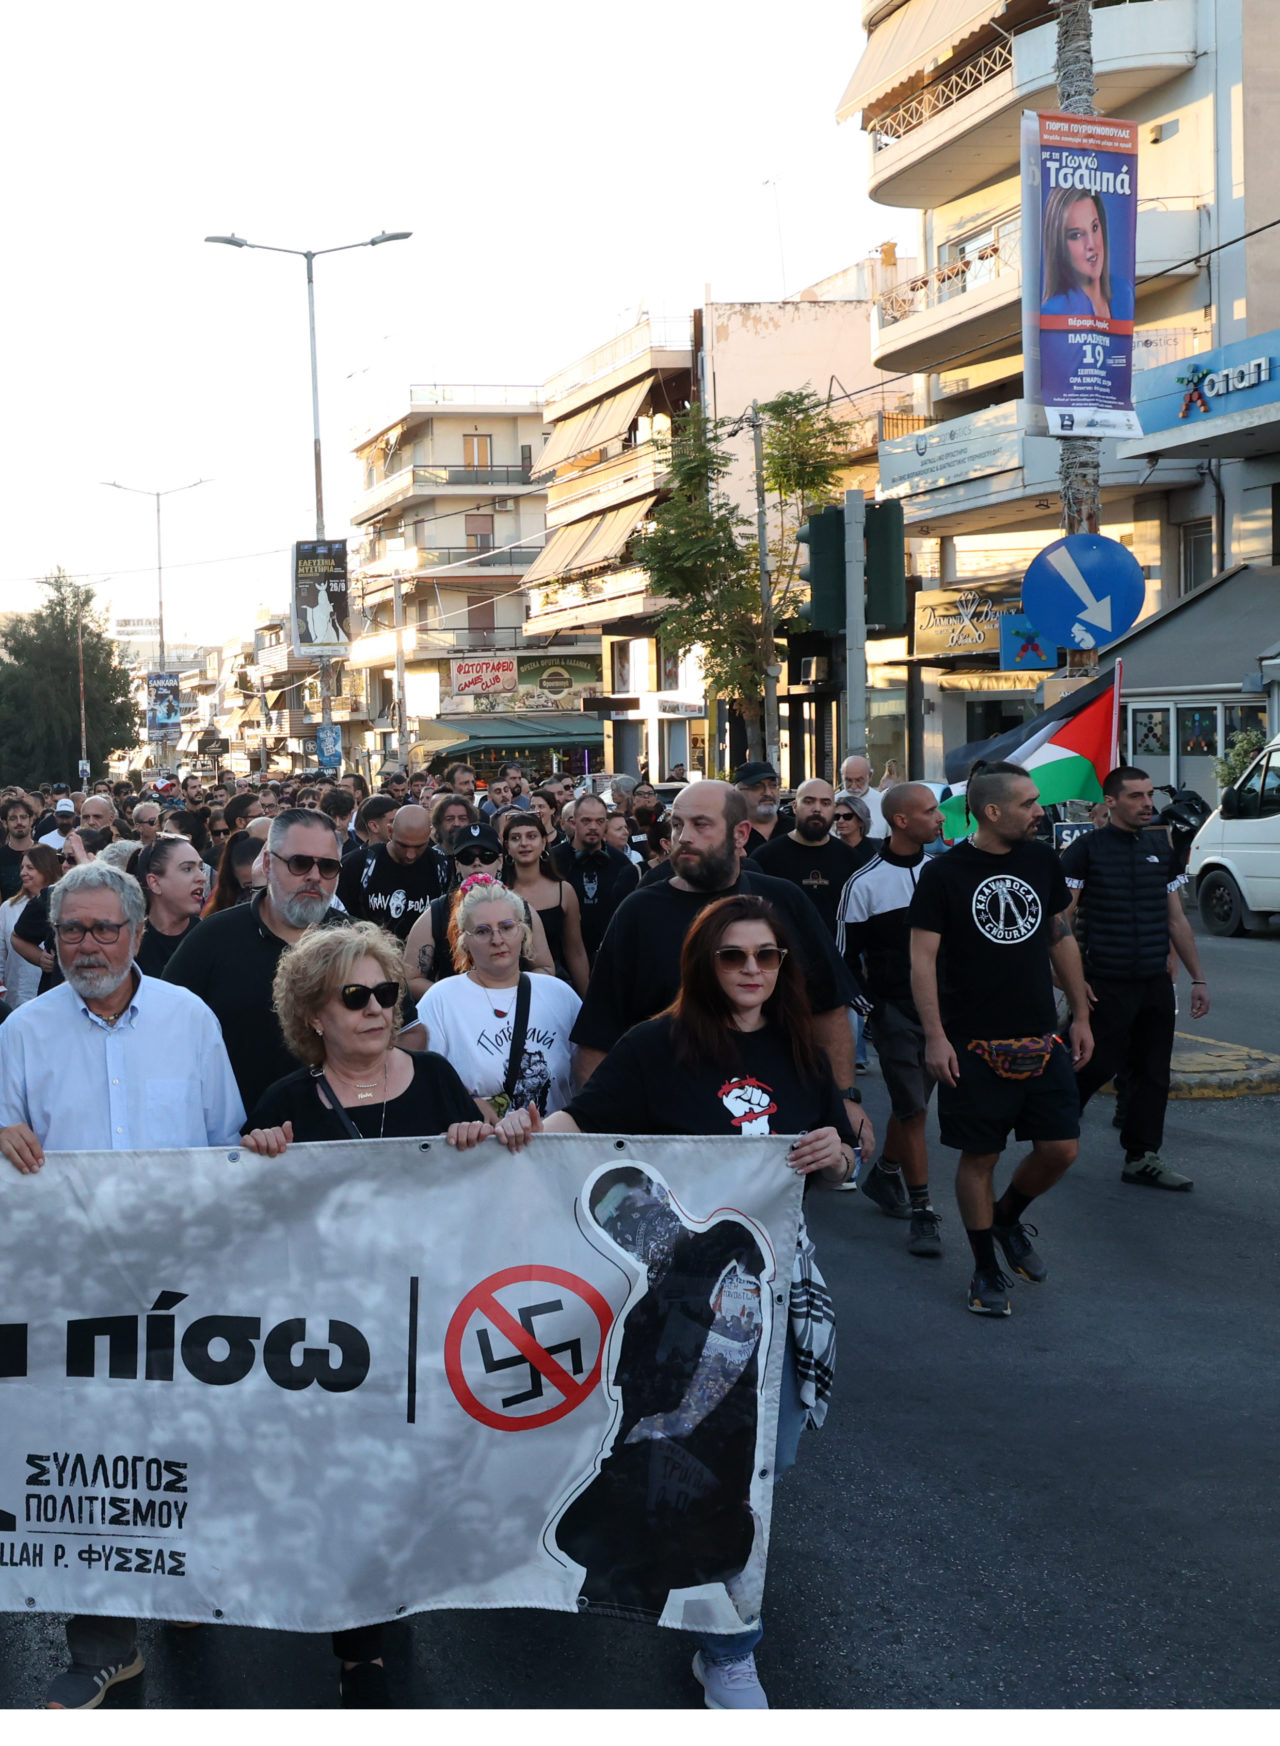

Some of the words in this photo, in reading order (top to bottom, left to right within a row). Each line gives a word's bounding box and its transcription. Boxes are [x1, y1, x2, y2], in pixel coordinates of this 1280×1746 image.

[1046, 121, 1068, 132] ΓΙΟΡΤΗ
[1042, 151, 1051, 160] με
[1061, 151, 1098, 170] Γωγώ
[1046, 160, 1131, 196] Τσαμπά
[1082, 344, 1104, 368] 19
[329, 582, 346, 592] 26/9
[457, 660, 513, 675] ΦΩΤΟΓΡΑΦΕΙΟ
[148, 679, 178, 687] SANKARA
[457, 675, 483, 692] GAMES
[481, 675, 501, 691] CLUB
[368, 892, 390, 911] KRAV
[407, 894, 432, 913] BOCA
[976, 881, 997, 910] KRAV
[1005, 879, 1034, 902] BOCA
[984, 915, 1036, 939] CHOURAVE
[526, 1027, 557, 1050] ανά
[66, 1290, 371, 1394] πίσω
[25, 1452, 188, 1493] ΣΥΛΛΟΓΟΣ
[25, 1493, 188, 1529] ΠΟΛΙΤΙΣΜΟΥ
[78, 1543, 187, 1577] ΦΥΣΣΑΣ
